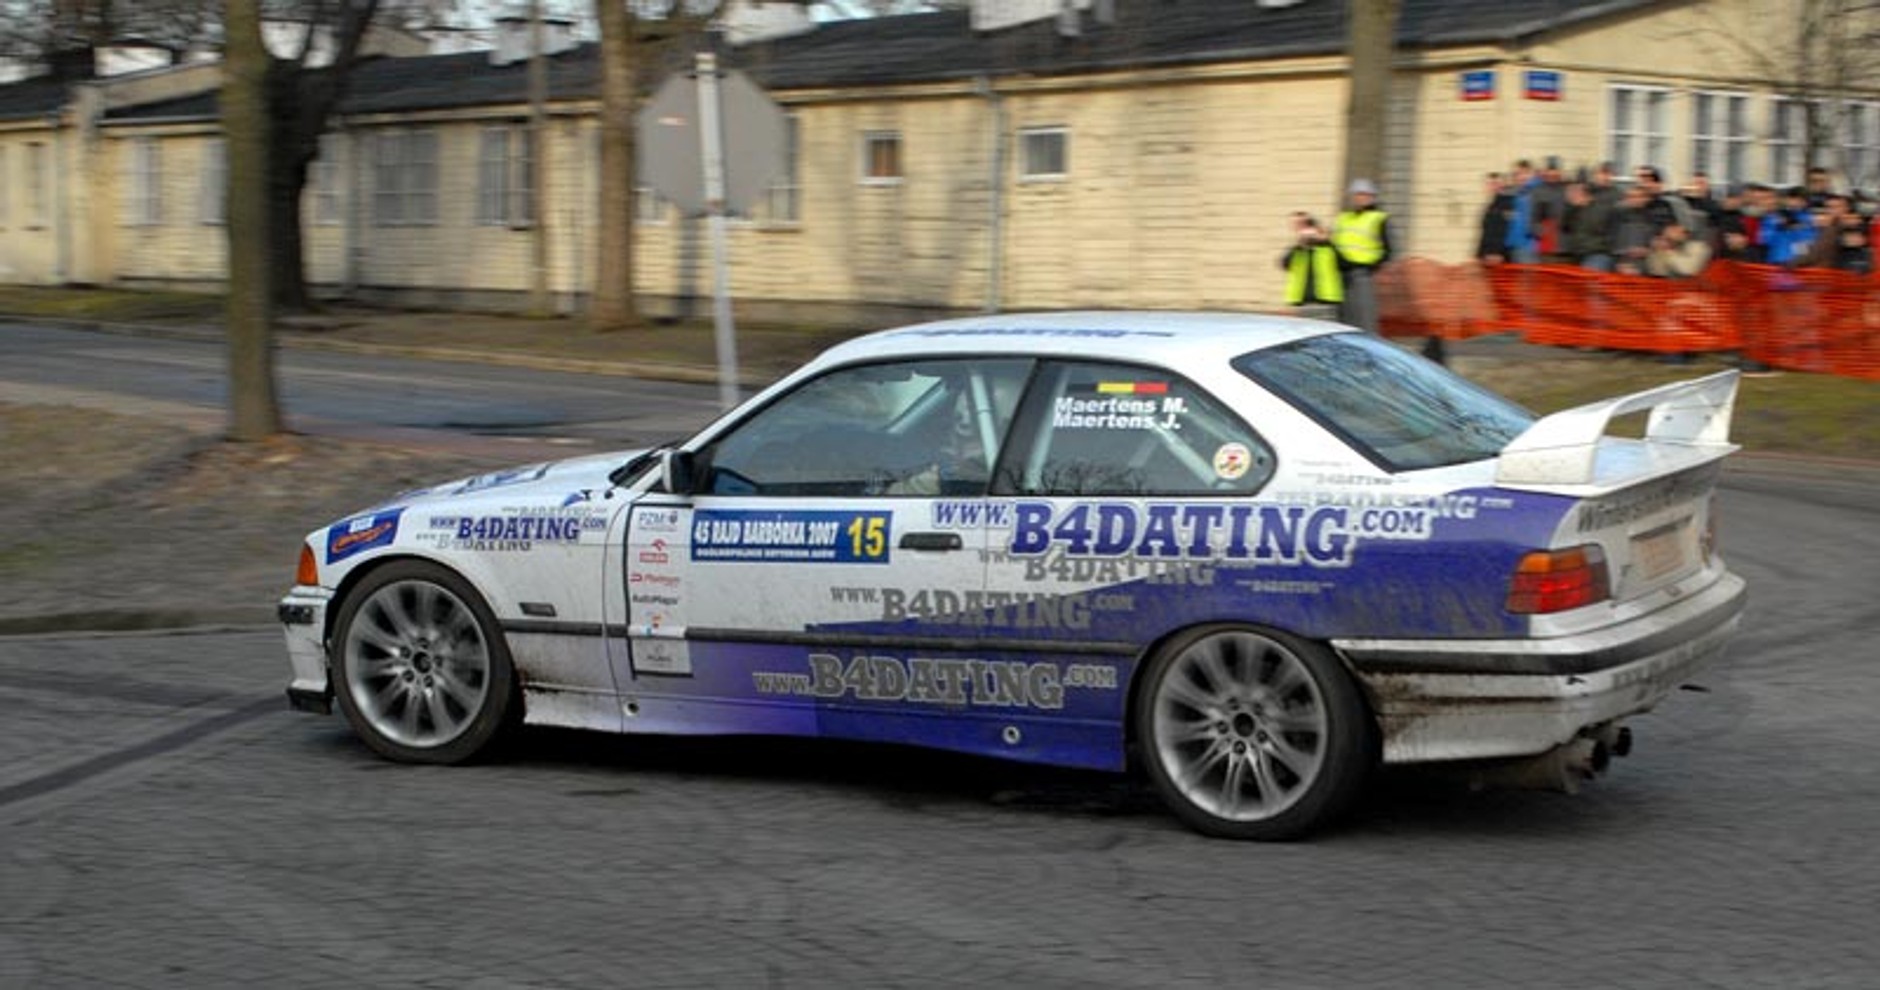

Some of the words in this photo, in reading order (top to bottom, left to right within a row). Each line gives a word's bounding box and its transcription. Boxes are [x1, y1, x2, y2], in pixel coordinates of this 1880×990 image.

[1055, 397, 1156, 413] Maertens
[1162, 397, 1188, 413] M.
[1052, 412, 1154, 429] Maertens
[1160, 413, 1181, 430] J.
[694, 520, 709, 544] 45
[711, 520, 742, 544] RAJD
[743, 514, 805, 545] BARBÓRKA
[808, 521, 839, 545] 2007
[848, 516, 886, 557] 15
